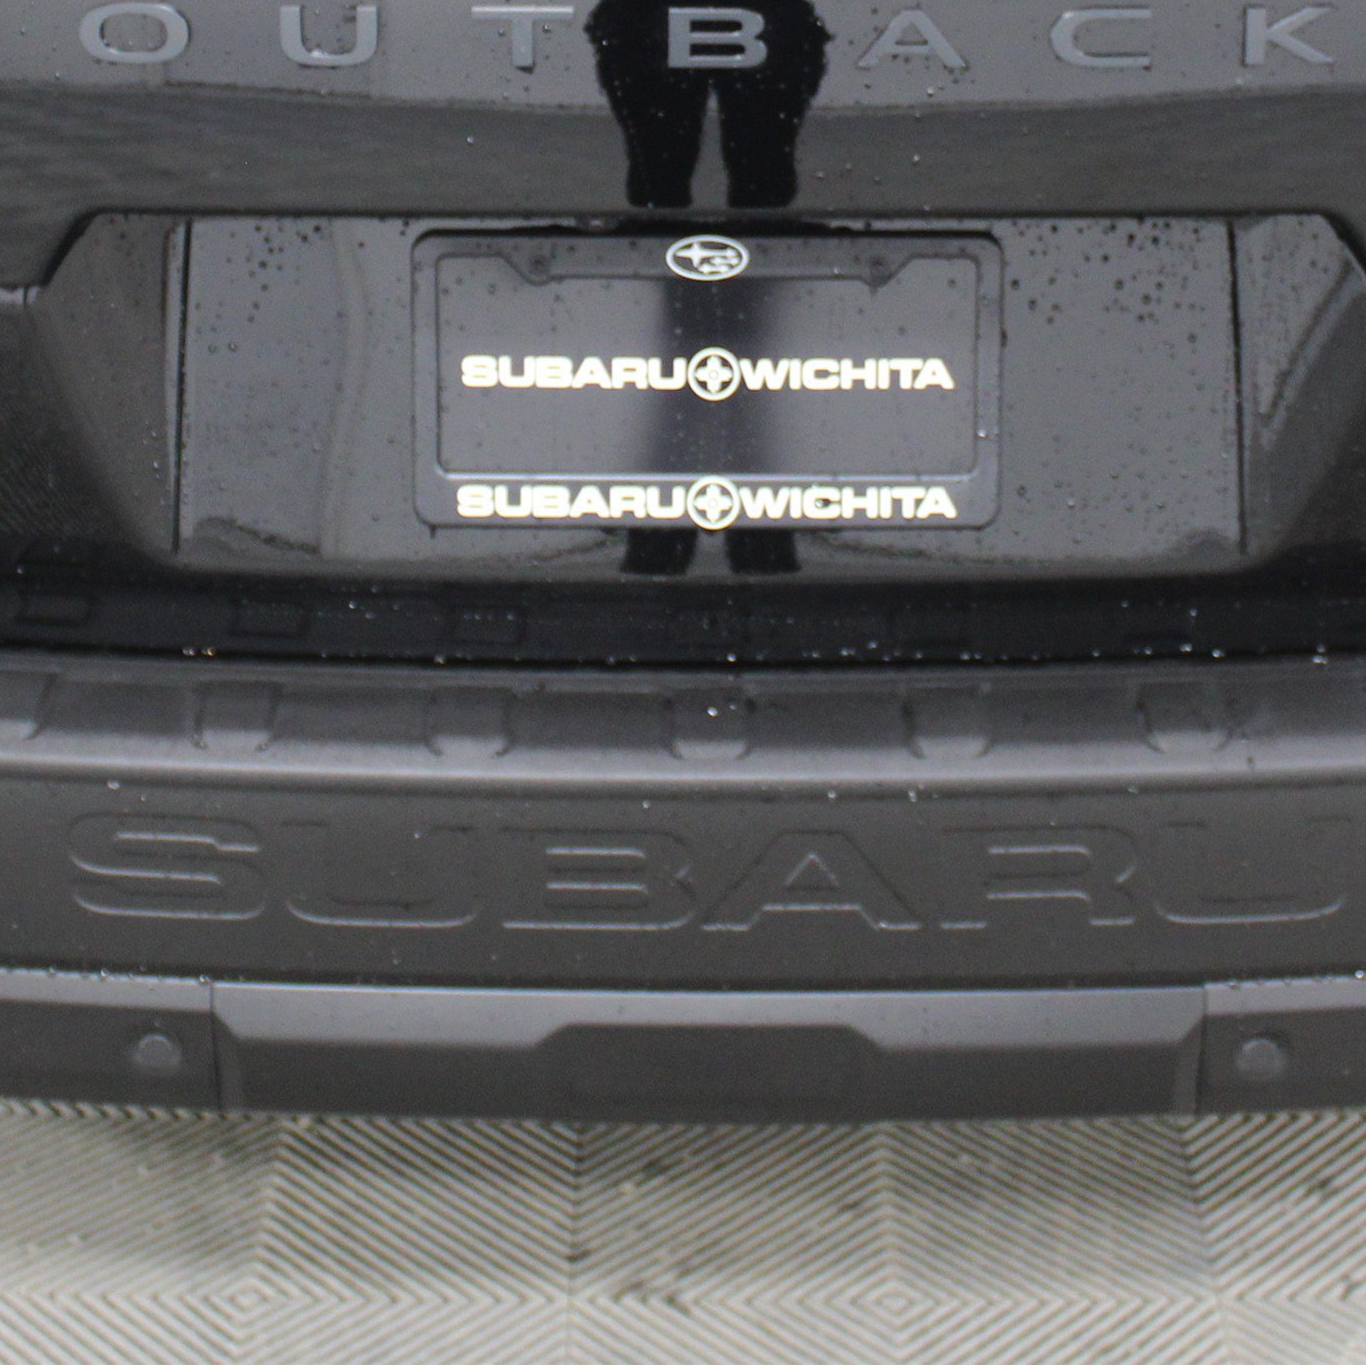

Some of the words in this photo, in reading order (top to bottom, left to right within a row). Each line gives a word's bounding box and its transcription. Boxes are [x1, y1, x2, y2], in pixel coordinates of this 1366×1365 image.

[79, 2, 1335, 69] OUTBACK
[461, 355, 687, 389] SUBARU
[738, 357, 956, 390] WICHITA
[456, 485, 687, 519] SUBARU
[738, 486, 957, 519] WICHITA
[65, 812, 1349, 933] SUBARU
